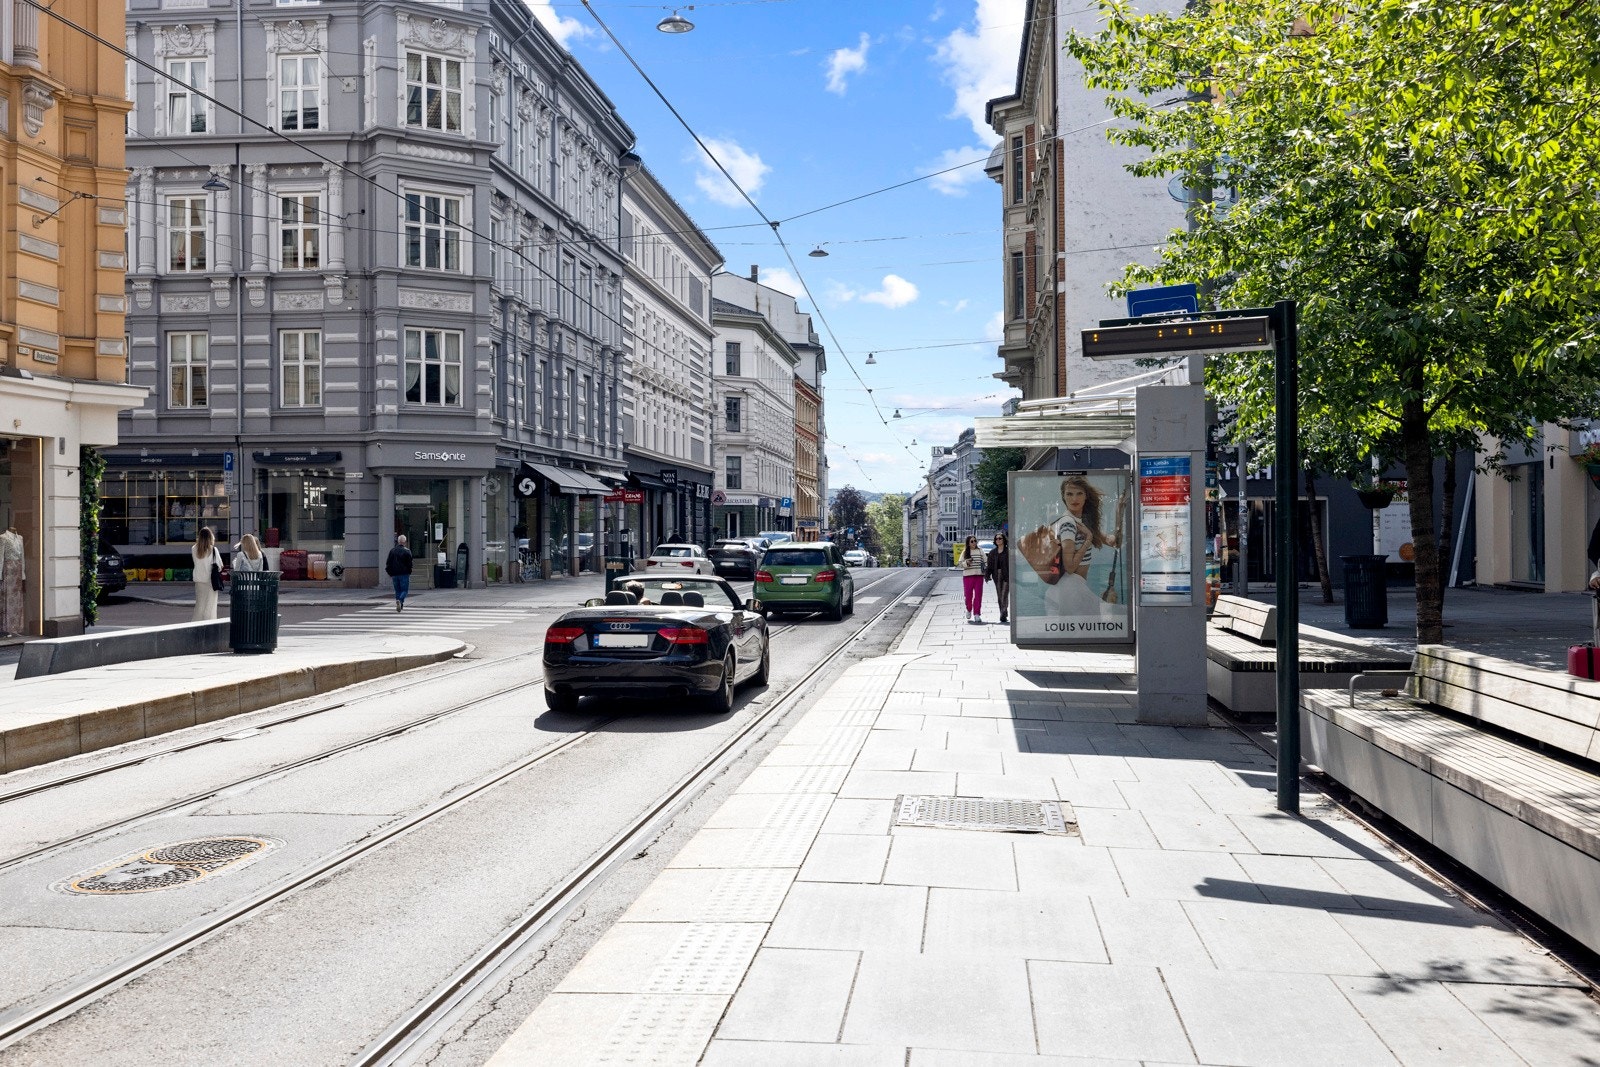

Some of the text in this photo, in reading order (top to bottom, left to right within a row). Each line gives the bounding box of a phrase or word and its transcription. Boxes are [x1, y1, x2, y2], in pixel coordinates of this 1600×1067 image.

[414, 451, 466, 461] Samsonite
[226, 455, 232, 468] P
[1045, 622, 1123, 632] LOUIS VUITTON
